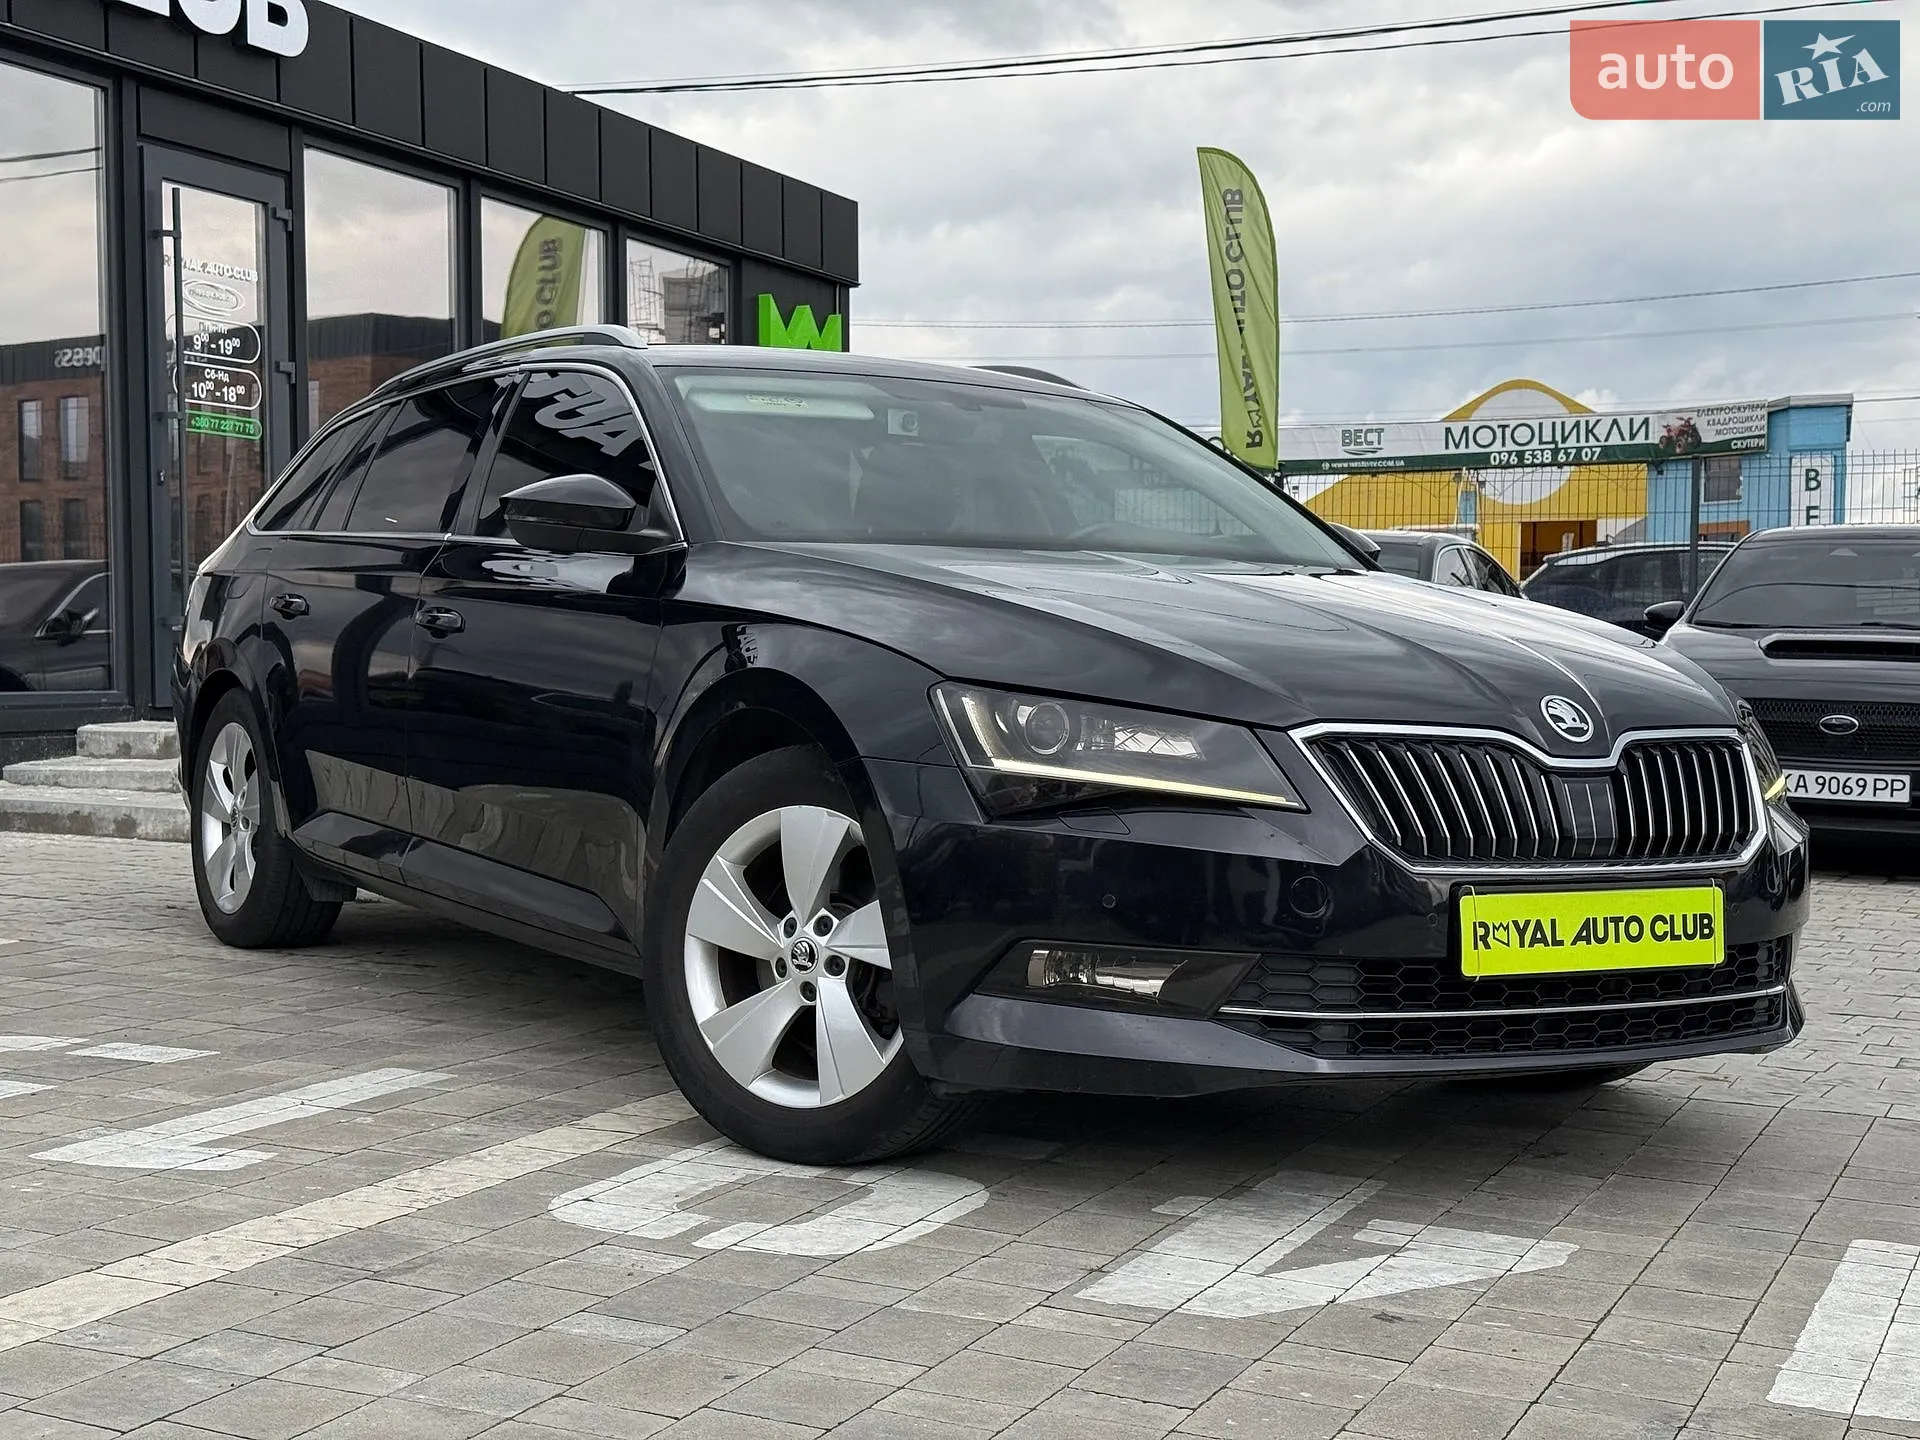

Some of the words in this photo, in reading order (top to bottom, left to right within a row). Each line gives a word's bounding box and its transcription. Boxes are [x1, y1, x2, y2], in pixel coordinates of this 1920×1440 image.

[1707, 413, 1765, 427] КВАДРОЦИКЛИ
[1444, 416, 1650, 450] МОТОЦИКЛИ
[1714, 425, 1765, 437] МОТОЦИКЛИ
[1730, 438, 1765, 450] СКУТЕРИ
[1490, 451, 1518, 466] 096
[1523, 450, 1551, 464] 538
[1557, 449, 1577, 463] 67
[1581, 447, 1602, 462] 07
[1814, 775, 1868, 797] 9069
[1872, 777, 1906, 798] PP
[1570, 914, 1645, 947] AUTO
[1649, 912, 1714, 943] CLUB
